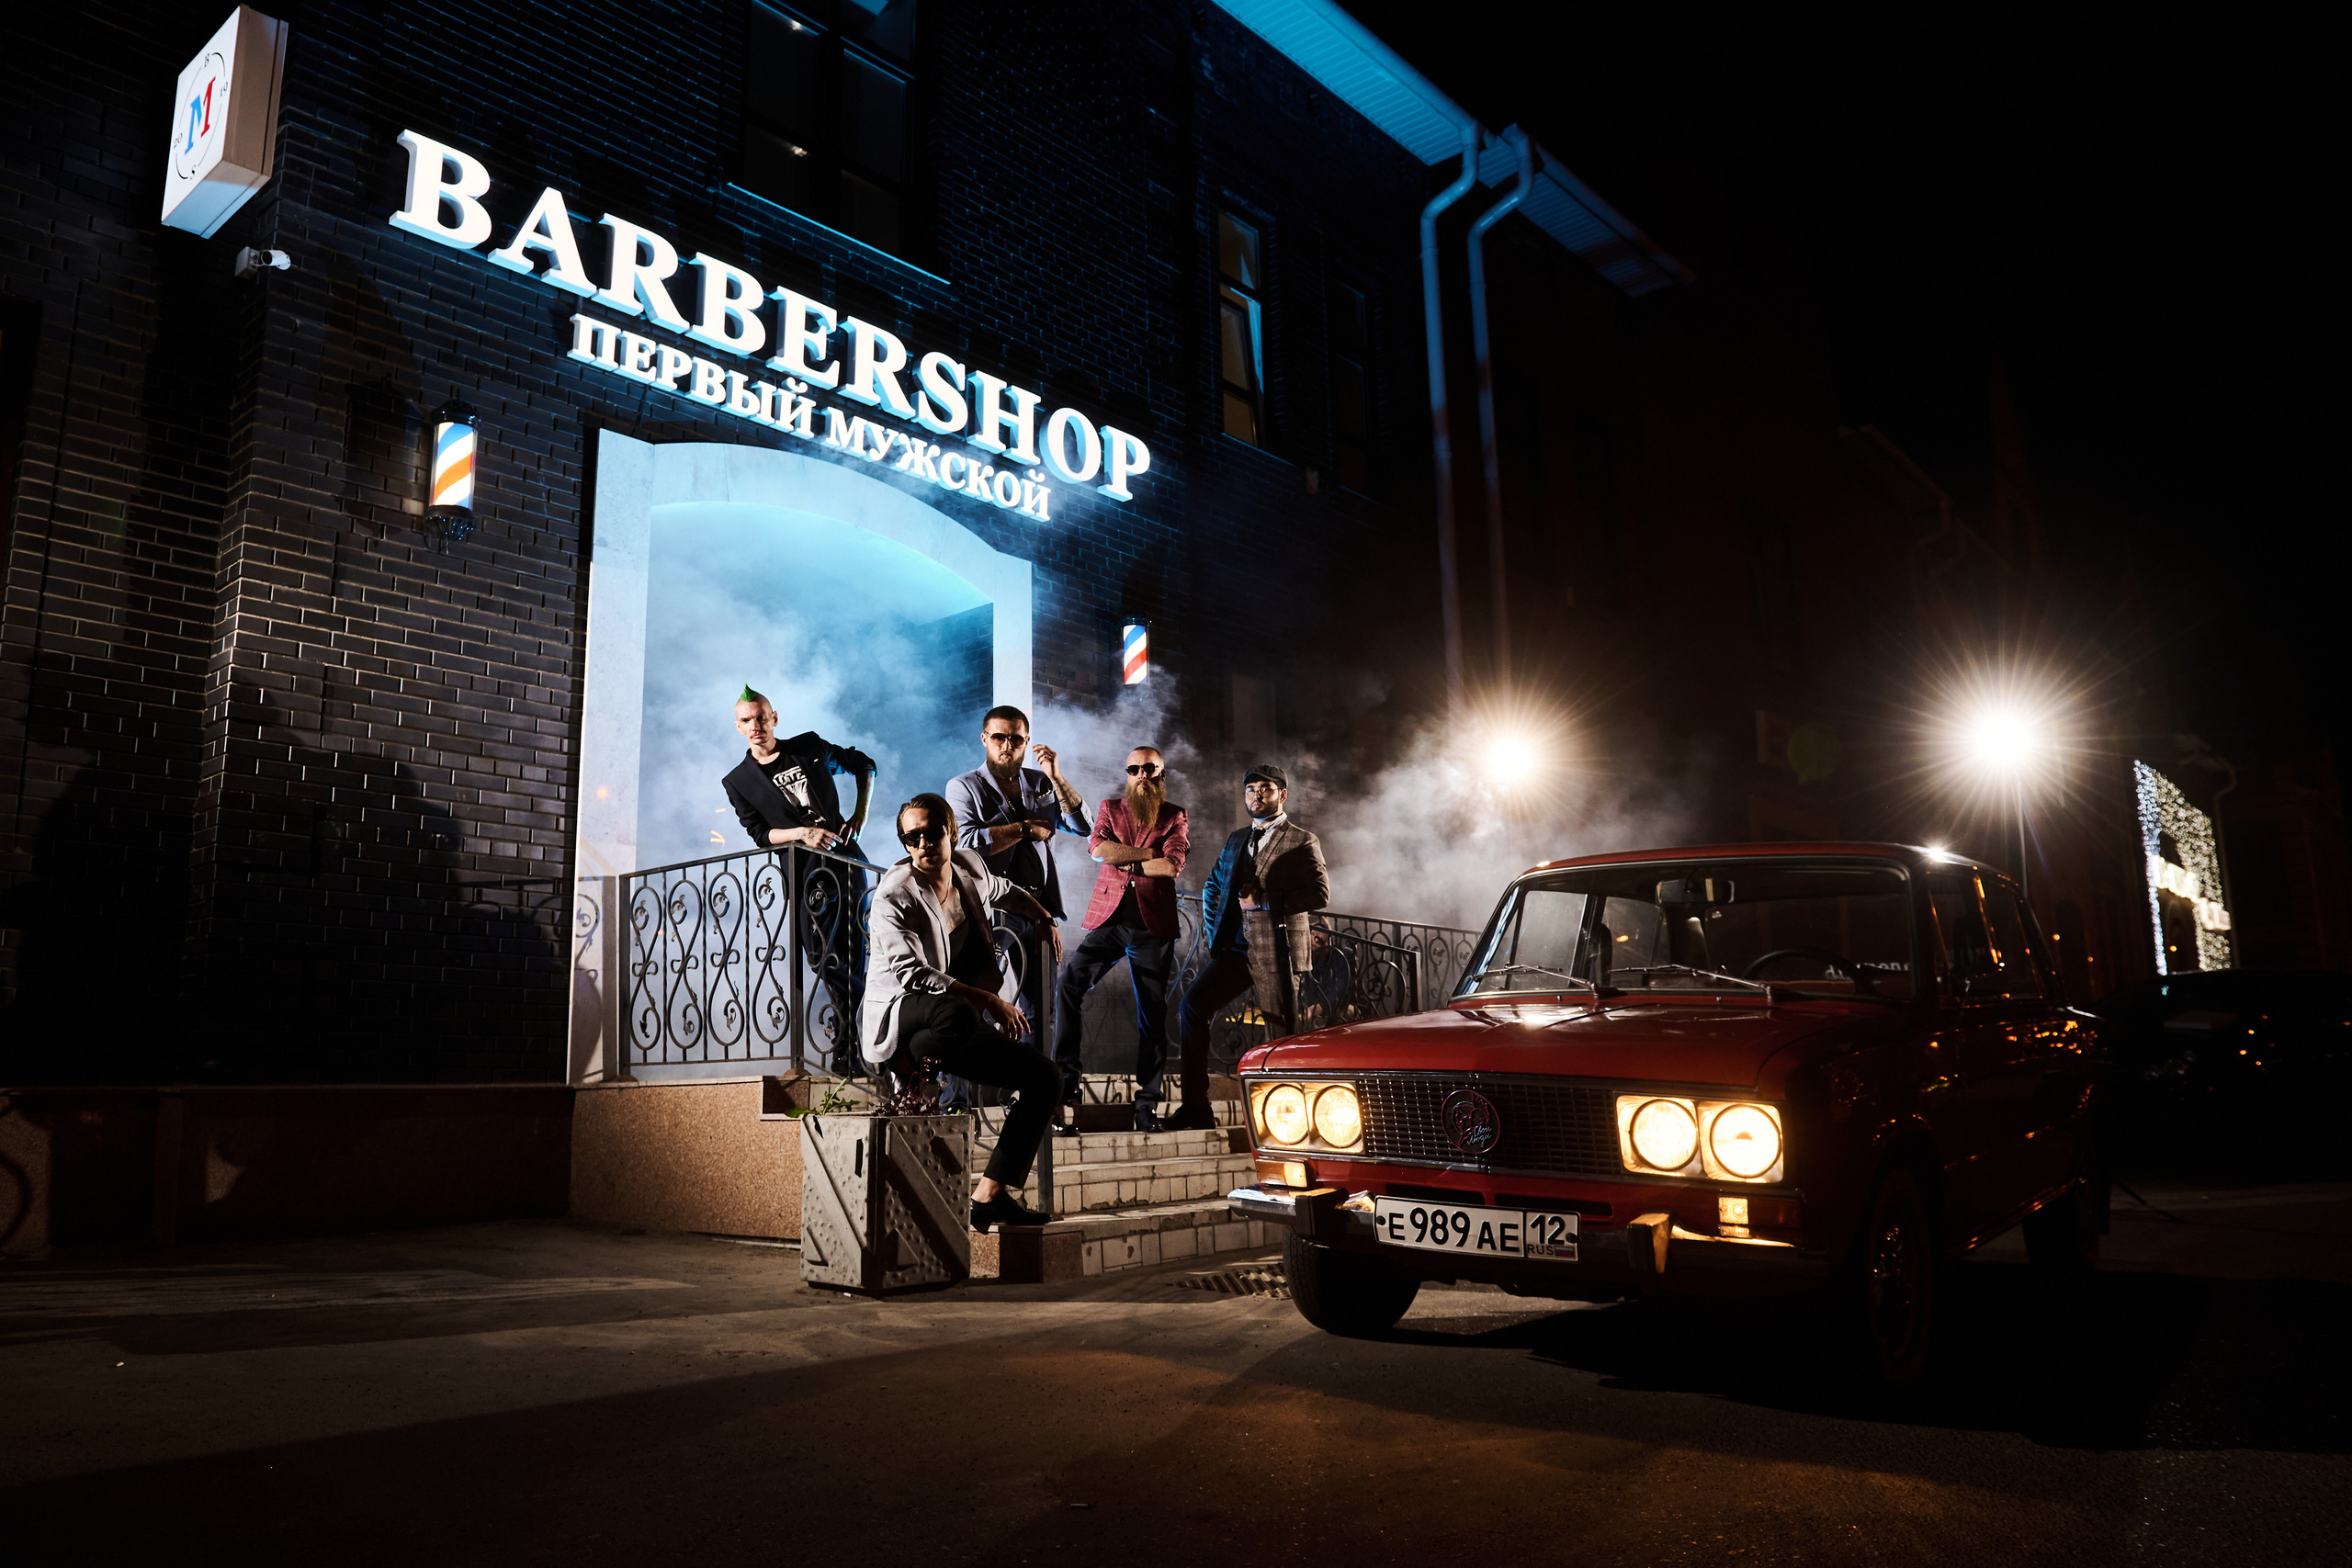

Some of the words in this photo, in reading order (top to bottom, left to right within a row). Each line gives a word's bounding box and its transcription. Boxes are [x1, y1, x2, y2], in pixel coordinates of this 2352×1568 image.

[173, 132, 183, 150] 20
[184, 75, 217, 156] M
[389, 129, 1151, 502] BARBERSHOP
[567, 313, 817, 439] ПЕРВЫЙ
[820, 406, 1052, 523] МУЖСКОЙ
[1527, 1243, 1555, 1256] RUS
[1530, 1214, 1566, 1247] 12
